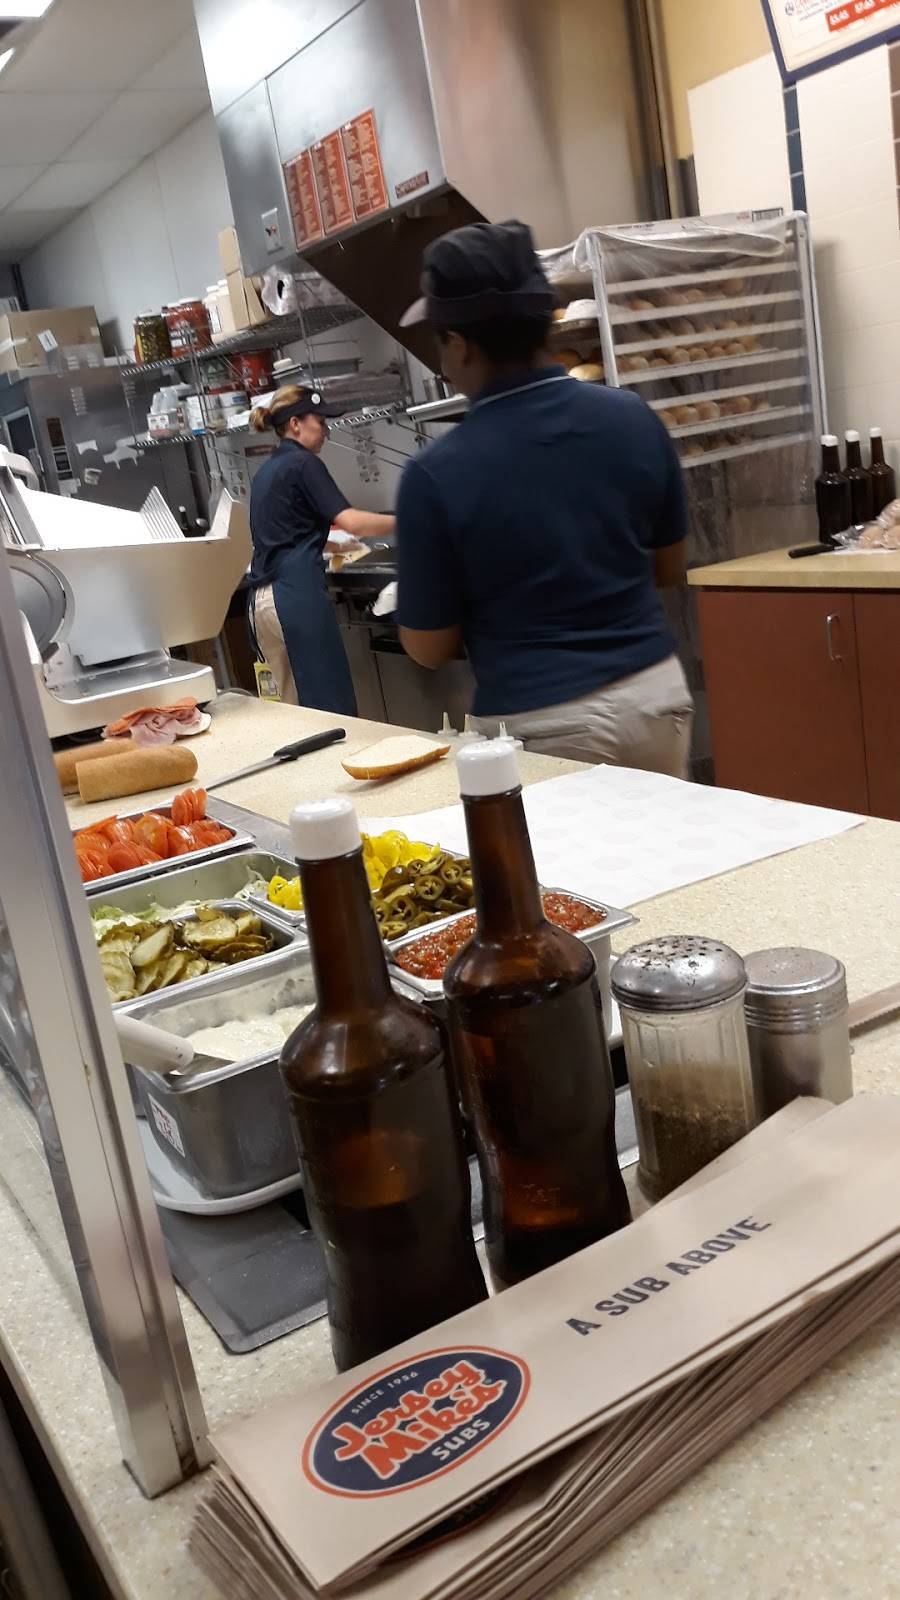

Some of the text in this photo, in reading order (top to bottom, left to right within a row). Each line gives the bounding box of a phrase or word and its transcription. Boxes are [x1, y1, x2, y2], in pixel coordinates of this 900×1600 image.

[566, 1215, 772, 1336] A SUB ABOVE
[333, 1361, 486, 1460] Jersey
[351, 1371, 419, 1415] SINCE 1956
[362, 1381, 507, 1479] Mike's
[432, 1419, 491, 1461] SUBS
